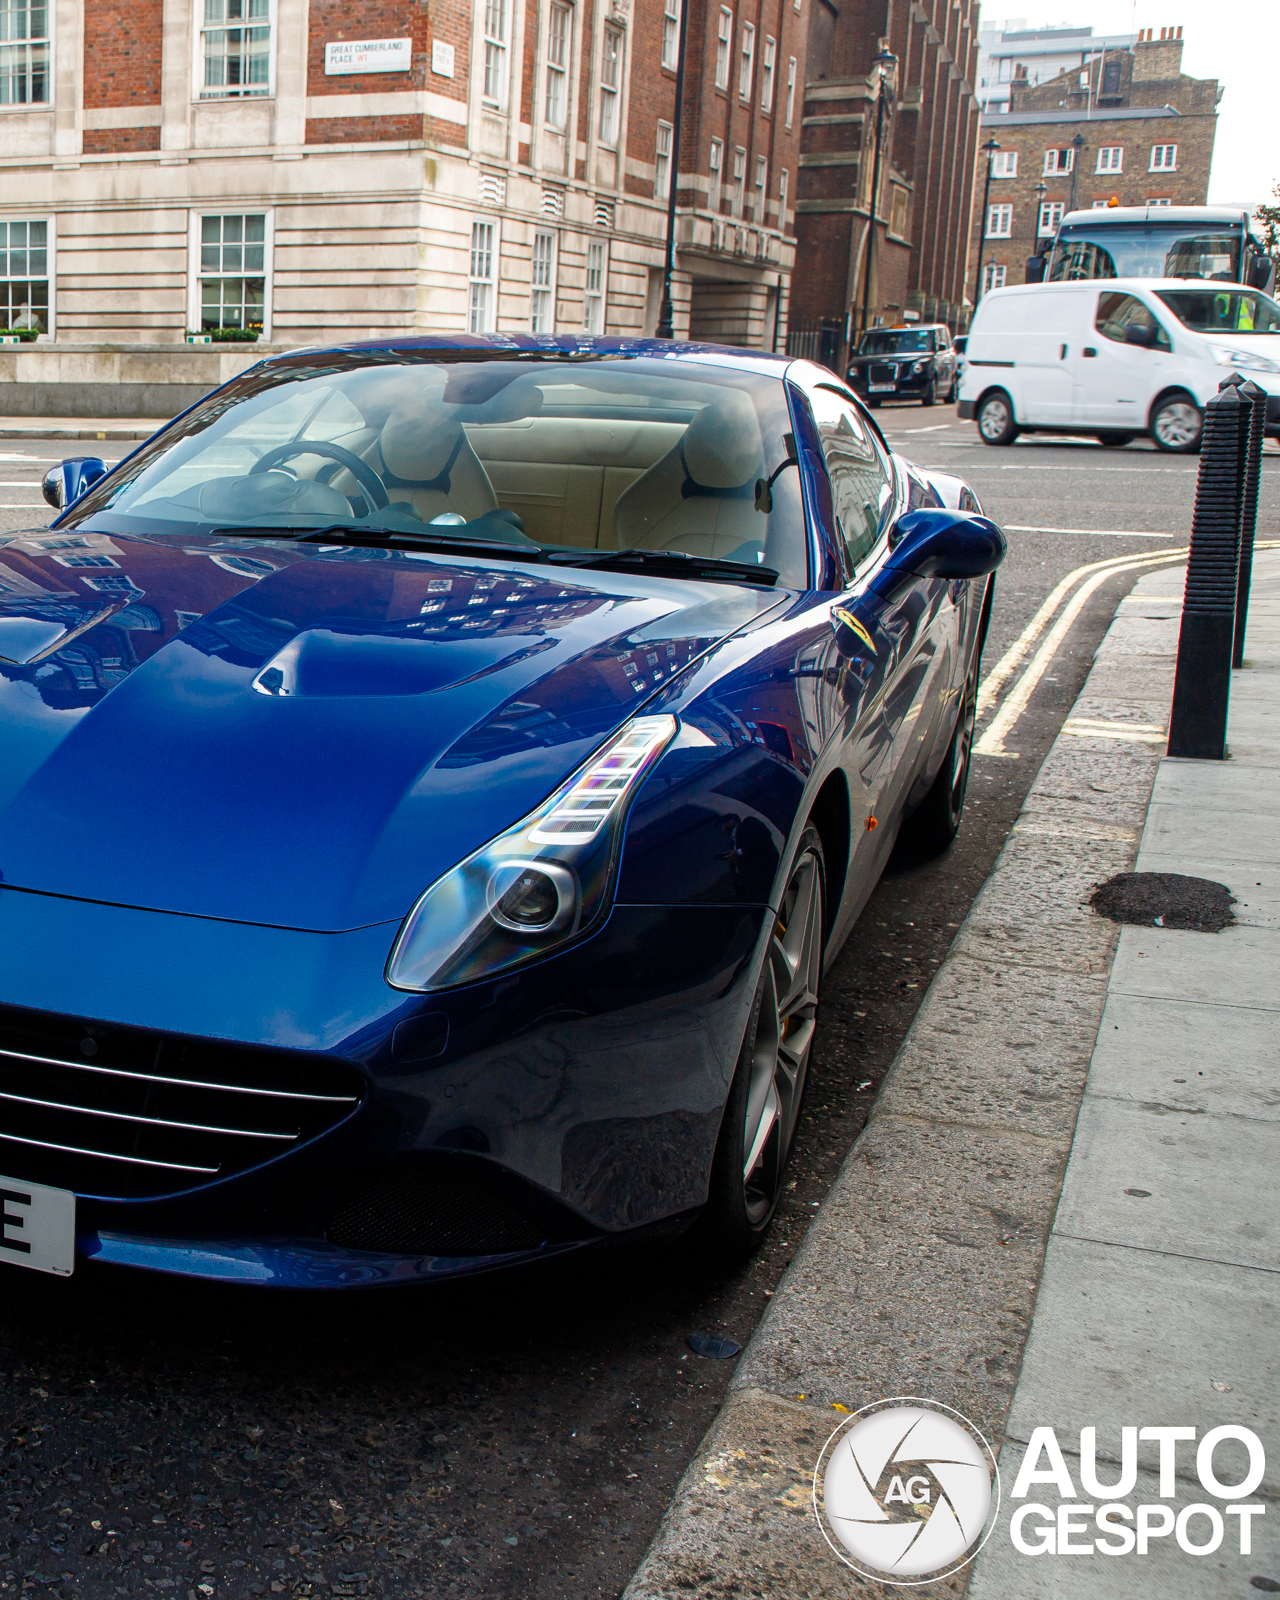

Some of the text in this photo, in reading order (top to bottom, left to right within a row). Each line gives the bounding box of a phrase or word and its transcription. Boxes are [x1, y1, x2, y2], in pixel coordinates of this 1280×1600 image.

[330, 42, 403, 54] GREAT CUMBERLAND
[330, 54, 368, 64] PLACE W1
